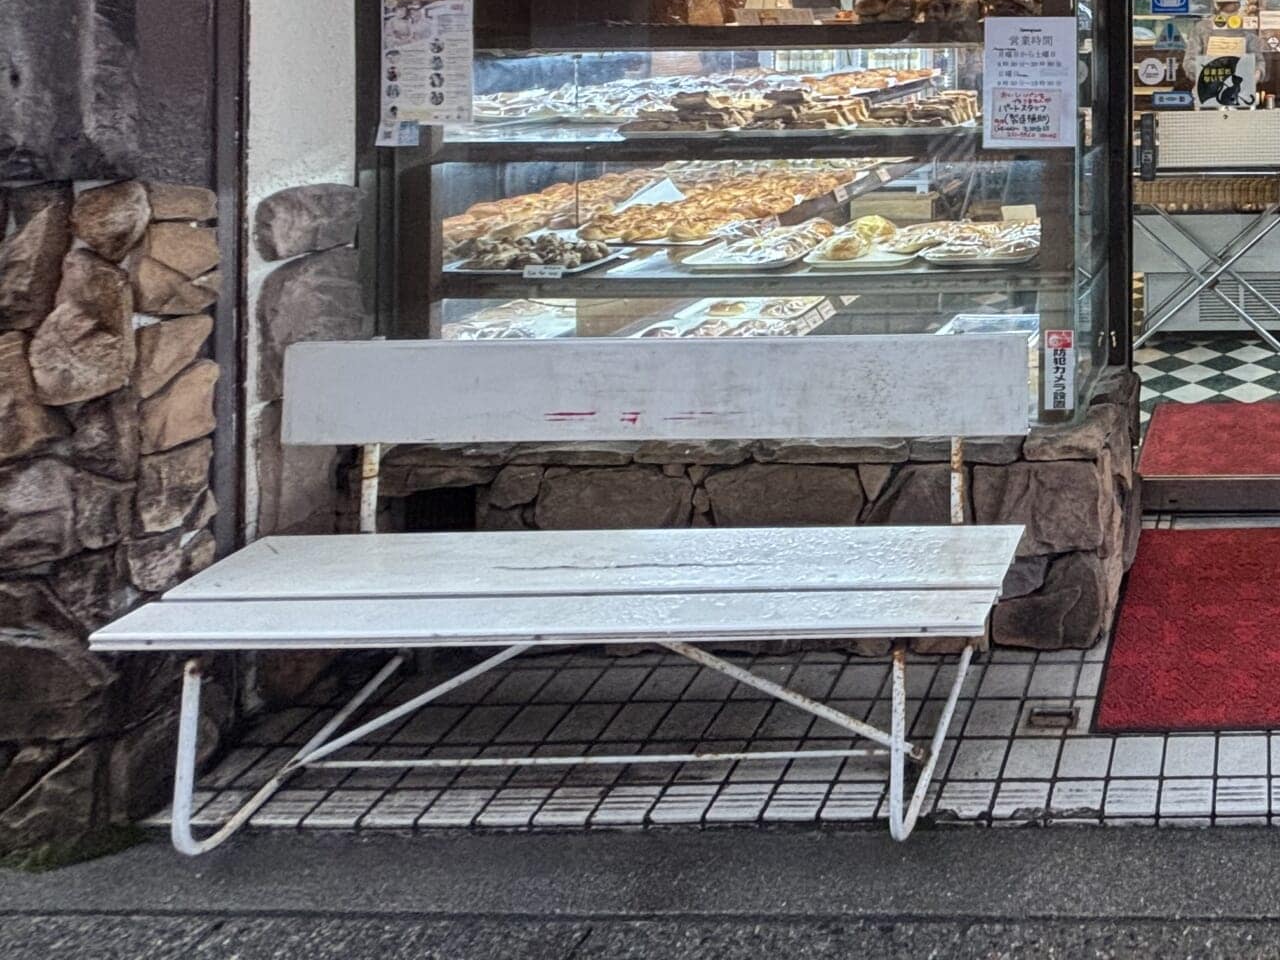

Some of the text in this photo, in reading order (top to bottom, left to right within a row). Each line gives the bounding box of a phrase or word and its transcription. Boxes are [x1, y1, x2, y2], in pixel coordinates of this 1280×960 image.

[1008, 35, 1054, 46] 営業時間
[1053, 349, 1066, 409] 防犯カメラ設置
